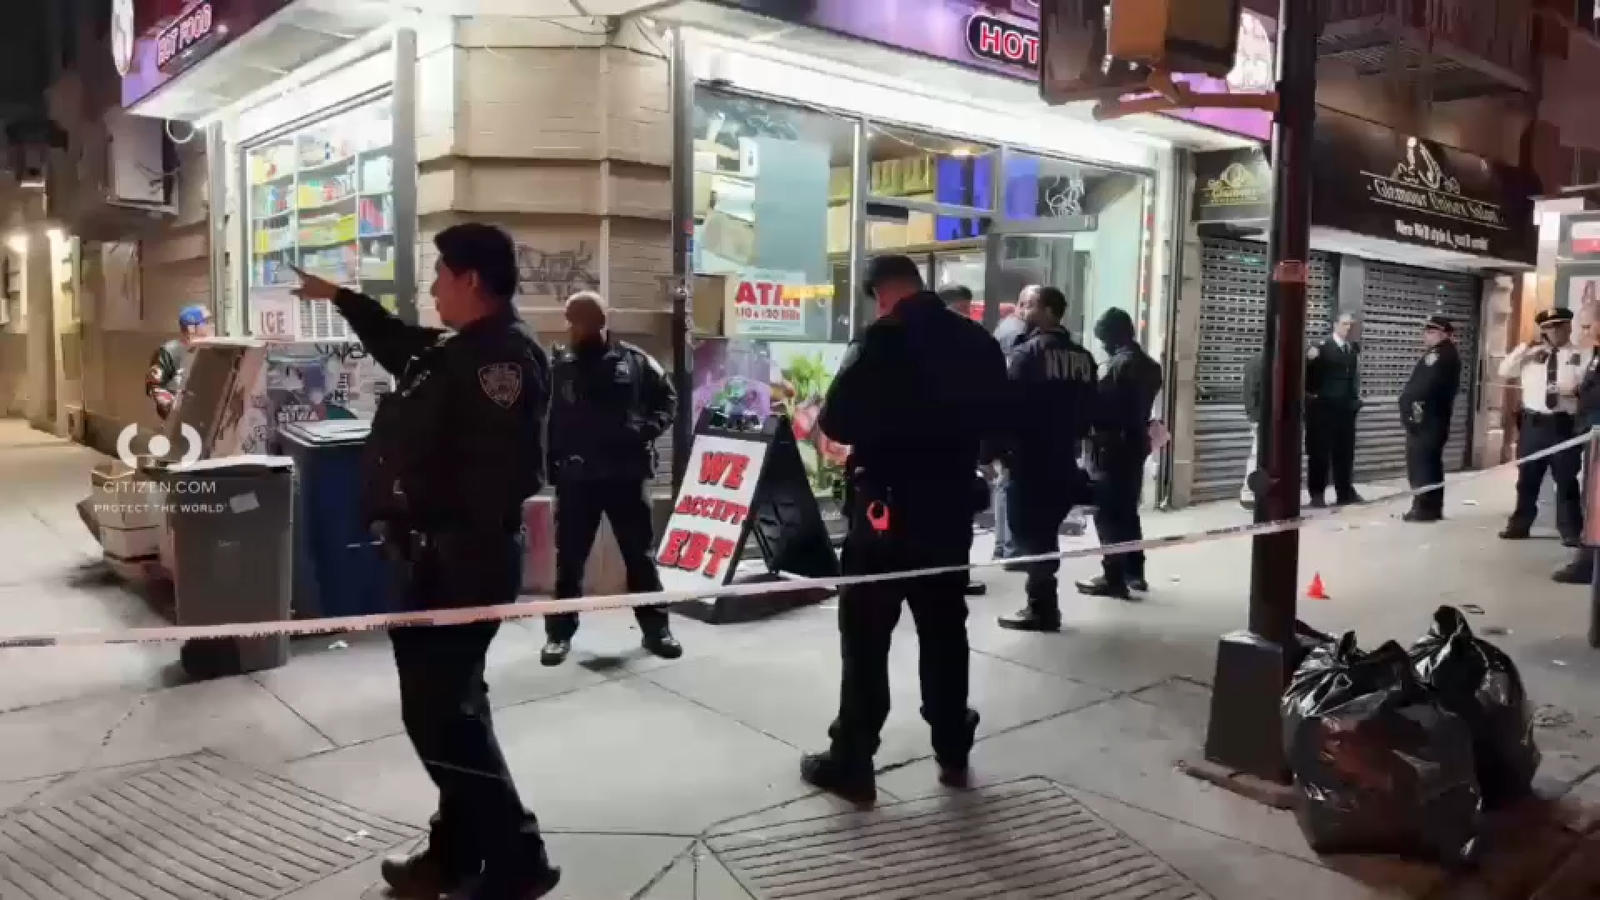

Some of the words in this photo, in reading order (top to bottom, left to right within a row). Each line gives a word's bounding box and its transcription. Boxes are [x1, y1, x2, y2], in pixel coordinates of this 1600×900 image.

[980, 21, 1040, 64] HOT
[260, 311, 286, 334] ICE
[1044, 349, 1091, 382] NYPD
[698, 451, 750, 490] WE
[674, 494, 749, 526] ACCEPT
[656, 528, 737, 578] EBT
